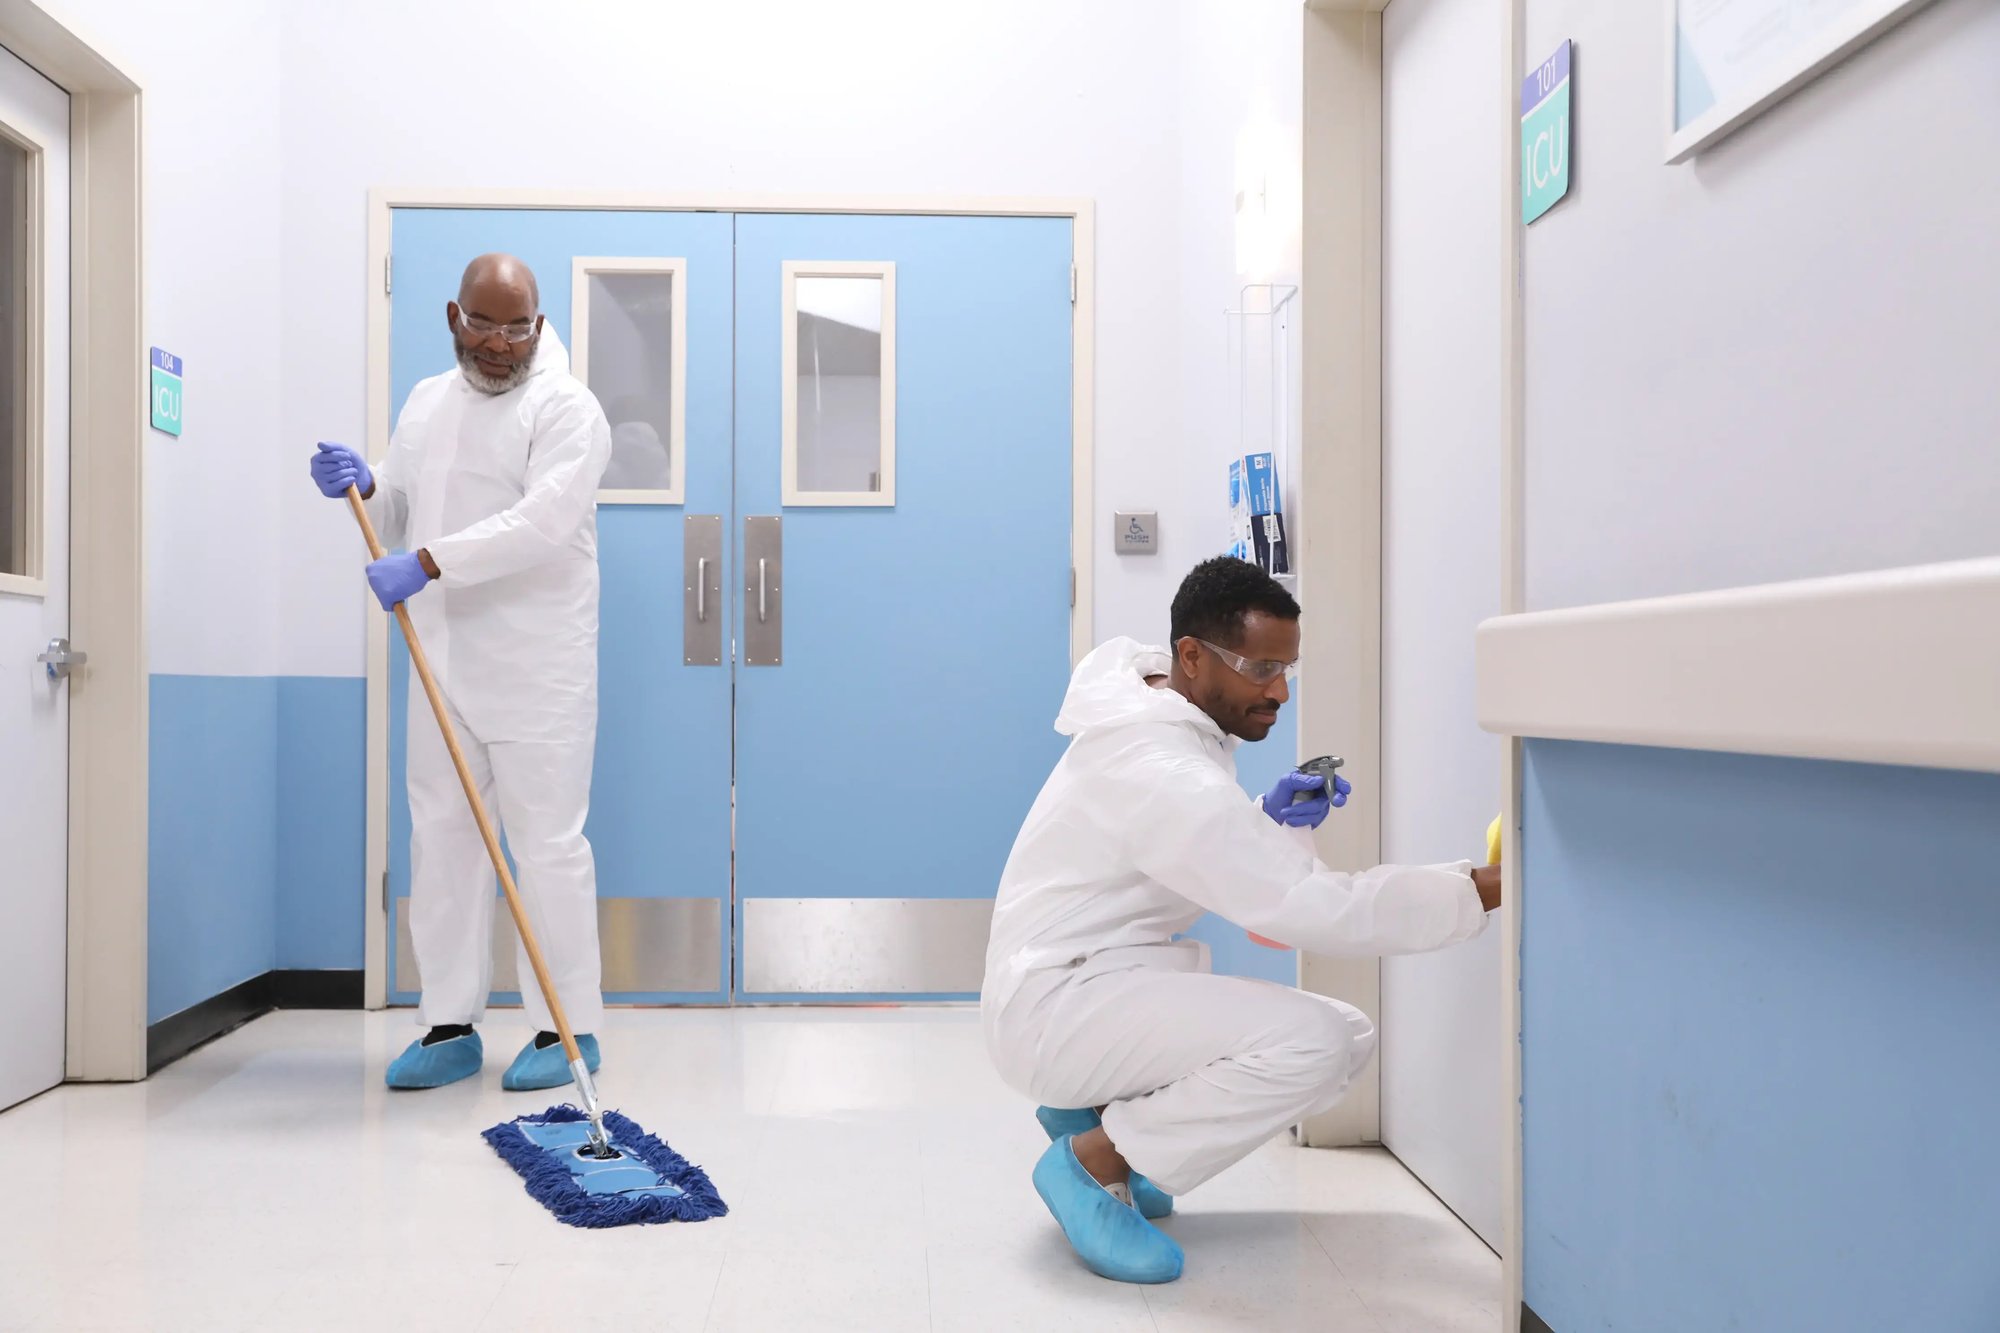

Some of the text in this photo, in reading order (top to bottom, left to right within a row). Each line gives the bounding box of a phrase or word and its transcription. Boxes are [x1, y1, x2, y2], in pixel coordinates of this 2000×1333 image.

[1536, 56, 1556, 96] 101
[1526, 115, 1564, 197] ICU
[160, 352, 173, 371] 104
[155, 385, 179, 421] ICU
